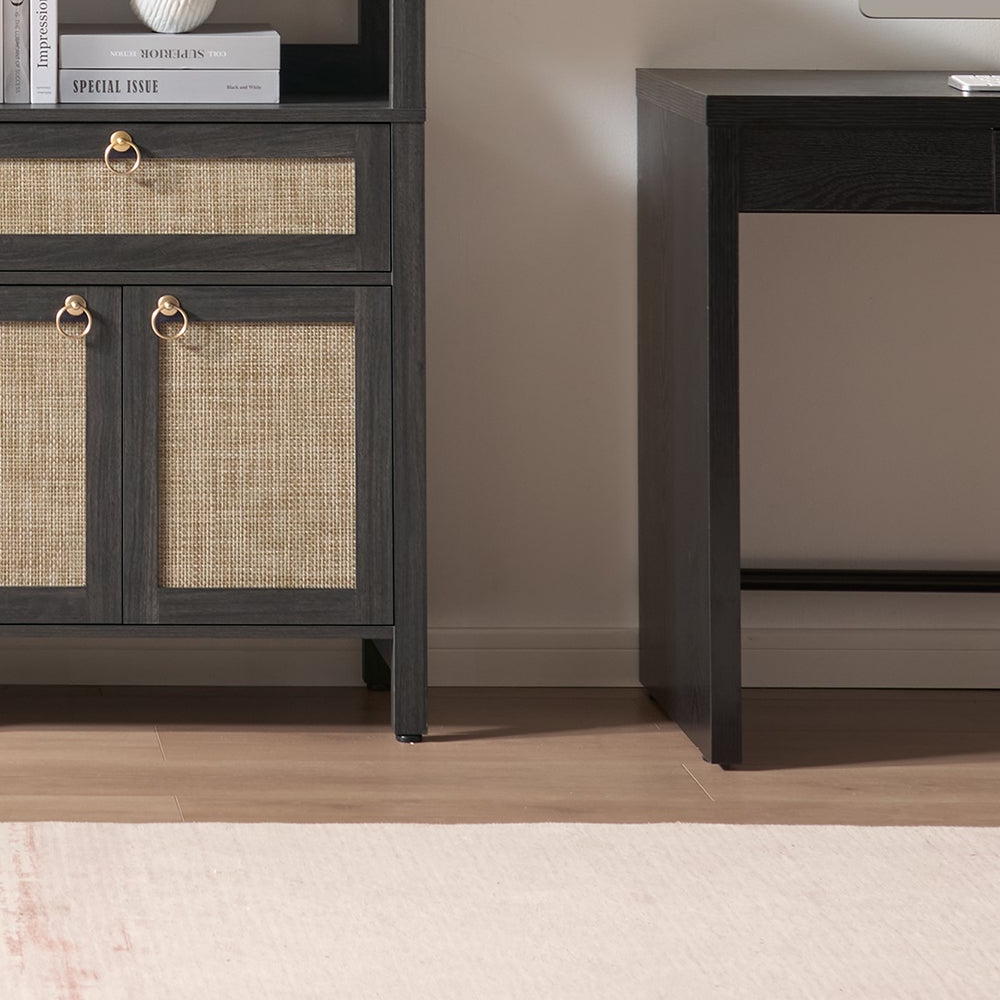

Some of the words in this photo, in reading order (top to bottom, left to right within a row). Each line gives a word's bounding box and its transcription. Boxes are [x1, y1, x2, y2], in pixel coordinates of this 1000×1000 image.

[141, 49, 204, 59] SUPERIOR
[72, 79, 122, 94] SPECIAL
[127, 79, 159, 94] ISSUE
